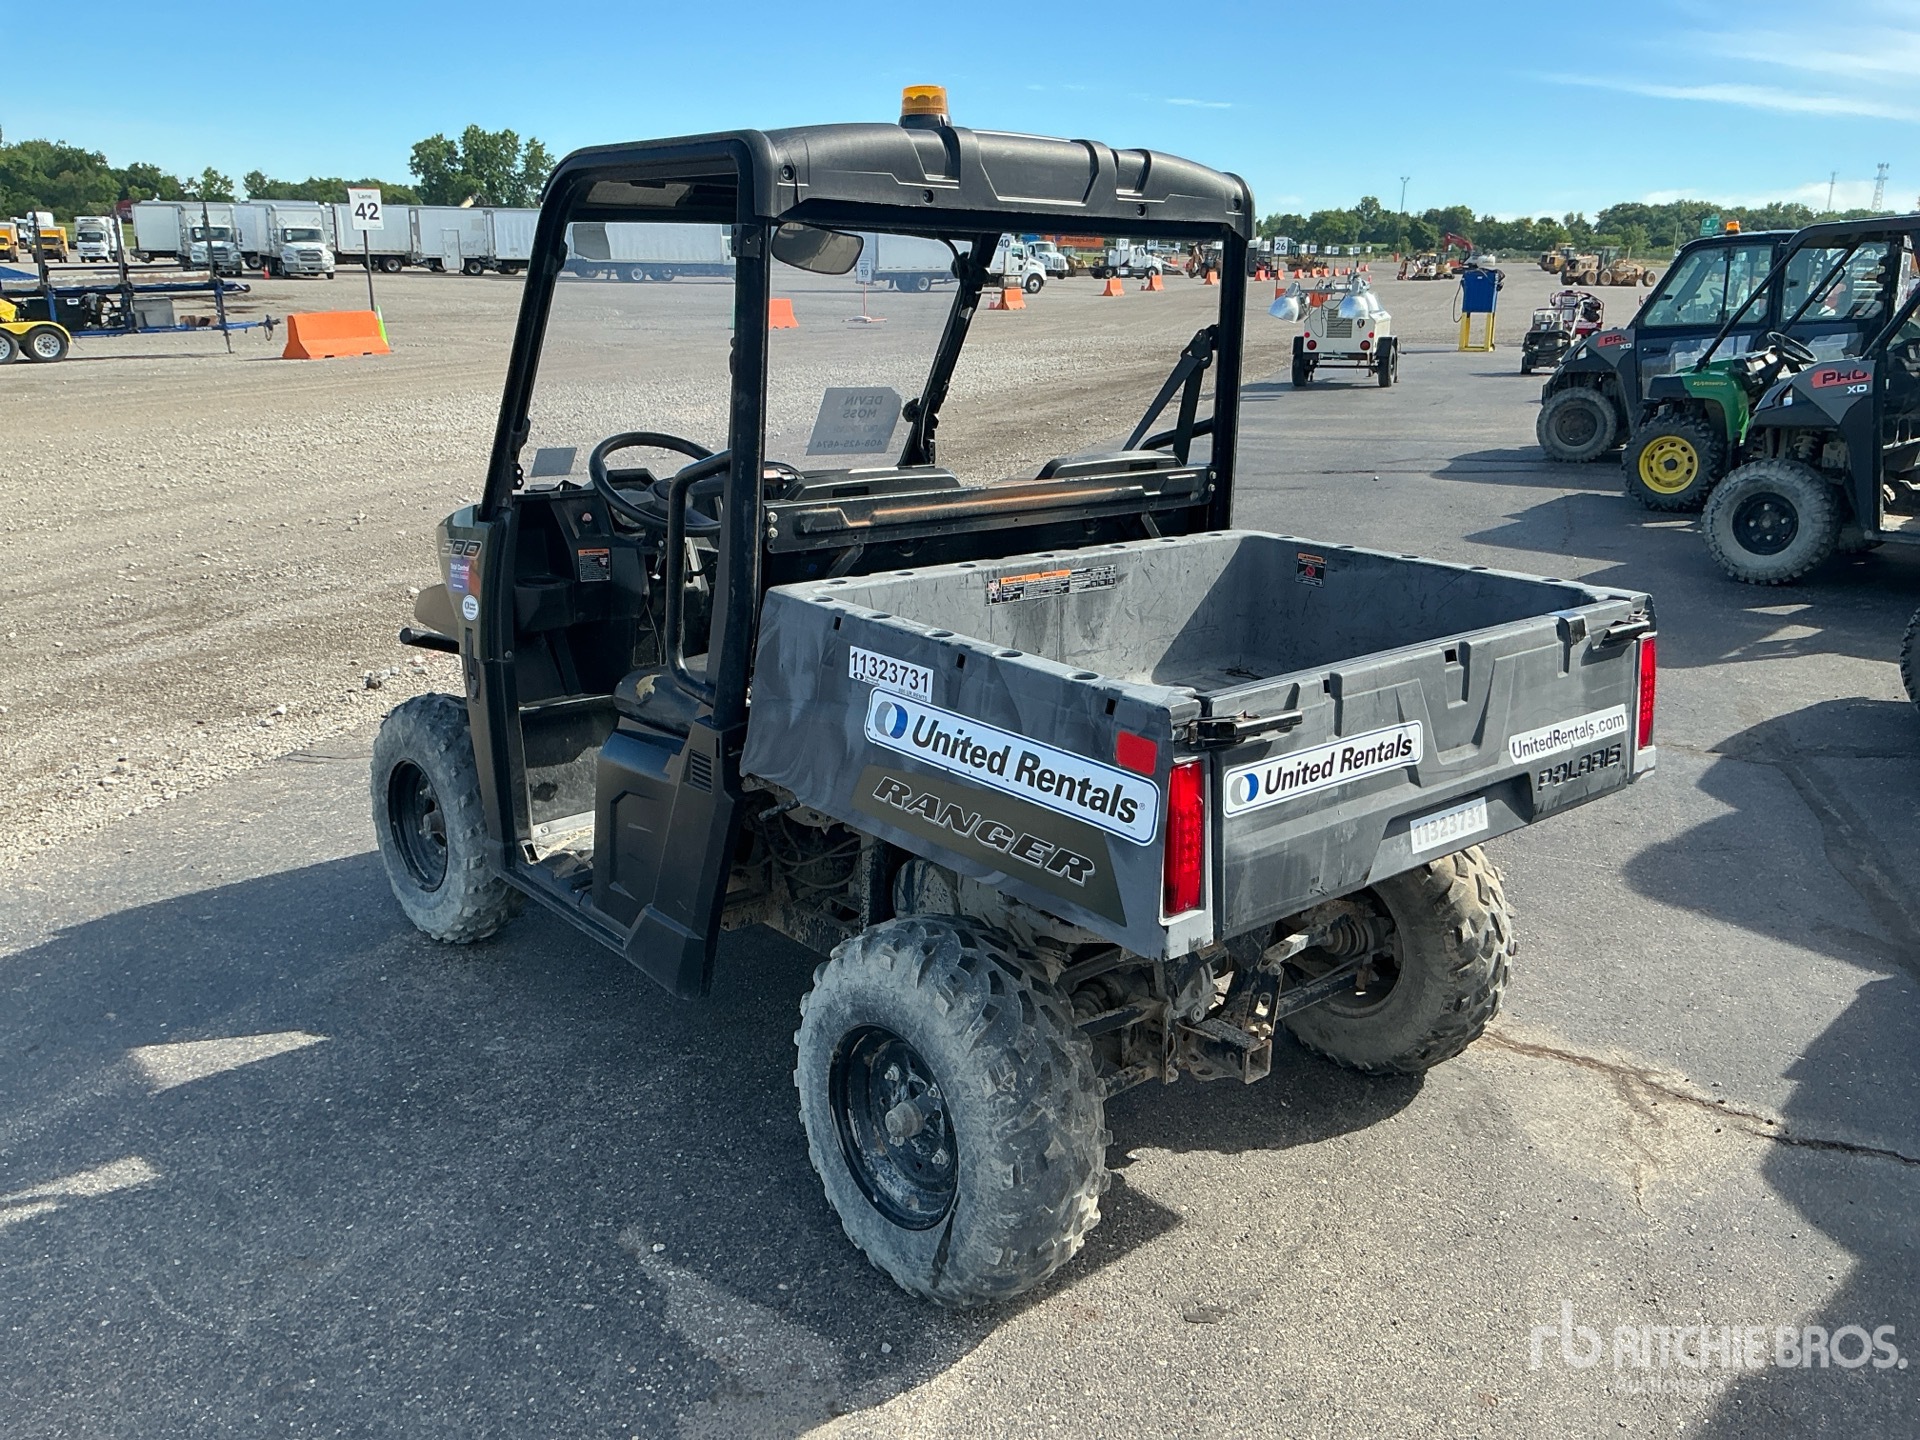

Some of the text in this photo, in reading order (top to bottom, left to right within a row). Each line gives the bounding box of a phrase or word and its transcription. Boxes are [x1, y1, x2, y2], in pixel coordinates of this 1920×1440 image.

[354, 202, 380, 220] 42
[999, 238, 1010, 248] 40
[1275, 242, 1286, 251] 26
[1619, 342, 1632, 350] XD
[1846, 384, 1868, 394] XD
[851, 651, 929, 693] 11323731
[1511, 713, 1625, 759] UnitedRentals.com
[912, 715, 1138, 824] United Rentals
[1265, 733, 1413, 795] United Rentals
[1537, 743, 1622, 792] POLARIS
[872, 775, 1096, 888] RANGER
[1414, 804, 1485, 847] 11323731
